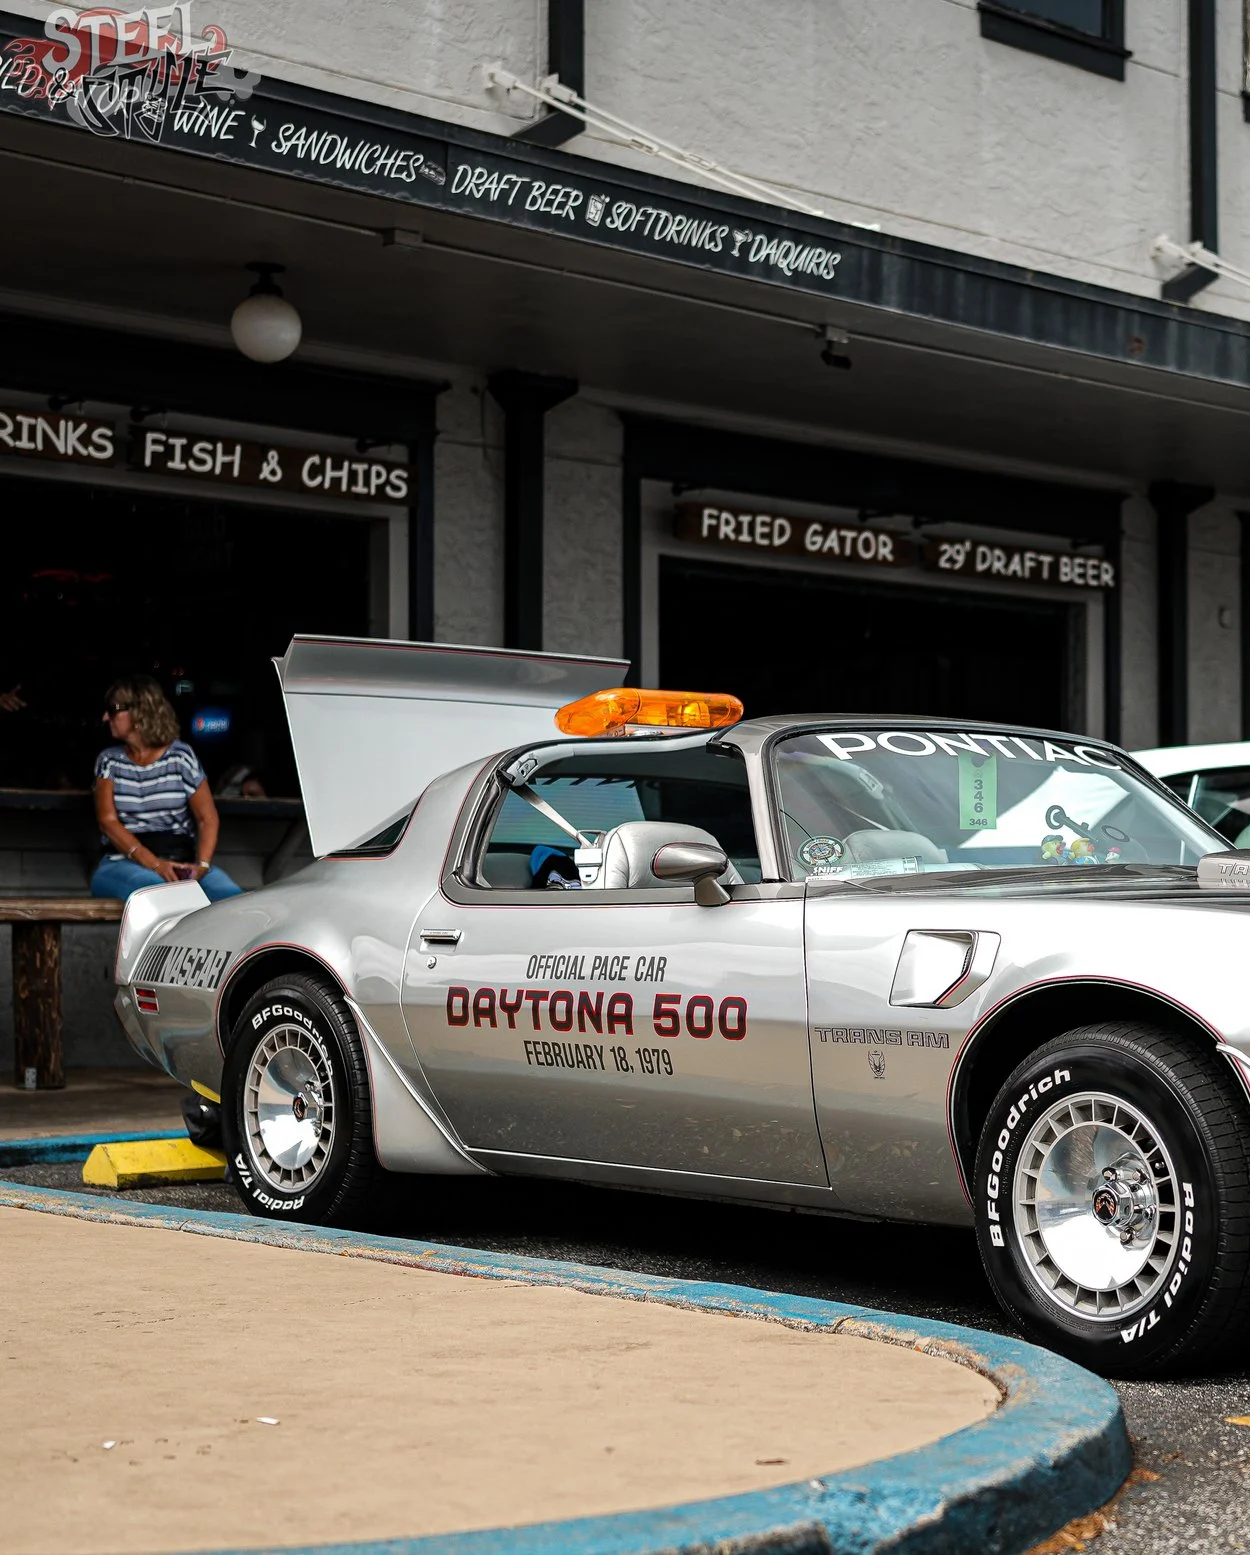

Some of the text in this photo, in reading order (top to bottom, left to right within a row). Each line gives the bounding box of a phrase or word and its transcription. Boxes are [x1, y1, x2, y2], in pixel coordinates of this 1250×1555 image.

[174, 101, 246, 140] WINE
[271, 123, 424, 183] SANDWICHES
[451, 165, 531, 206] DRAFT
[525, 180, 583, 220] BEER
[748, 233, 842, 280] DAIQUIRIS
[145, 431, 409, 499] FISH & CHIPS
[701, 507, 894, 562] FRIED GATOR
[976, 546, 1053, 581] DRAFT
[1059, 555, 1115, 587] BEER
[815, 731, 1122, 771] PONTIAC
[969, 818, 988, 826] 346
[160, 947, 227, 989] NASCAR
[525, 954, 668, 982] OFFICIAL PACE CAR
[446, 986, 748, 1041] DAYTONA 500
[251, 1004, 334, 1077] BFGoodrich
[523, 1040, 674, 1076] FEBRUARY 18, 1979
[814, 1027, 950, 1049] TRANS AM
[987, 1068, 1071, 1247] BFGoodrich
[253, 1187, 305, 1210] Radial
[1119, 1182, 1195, 1344] Radial T/A
